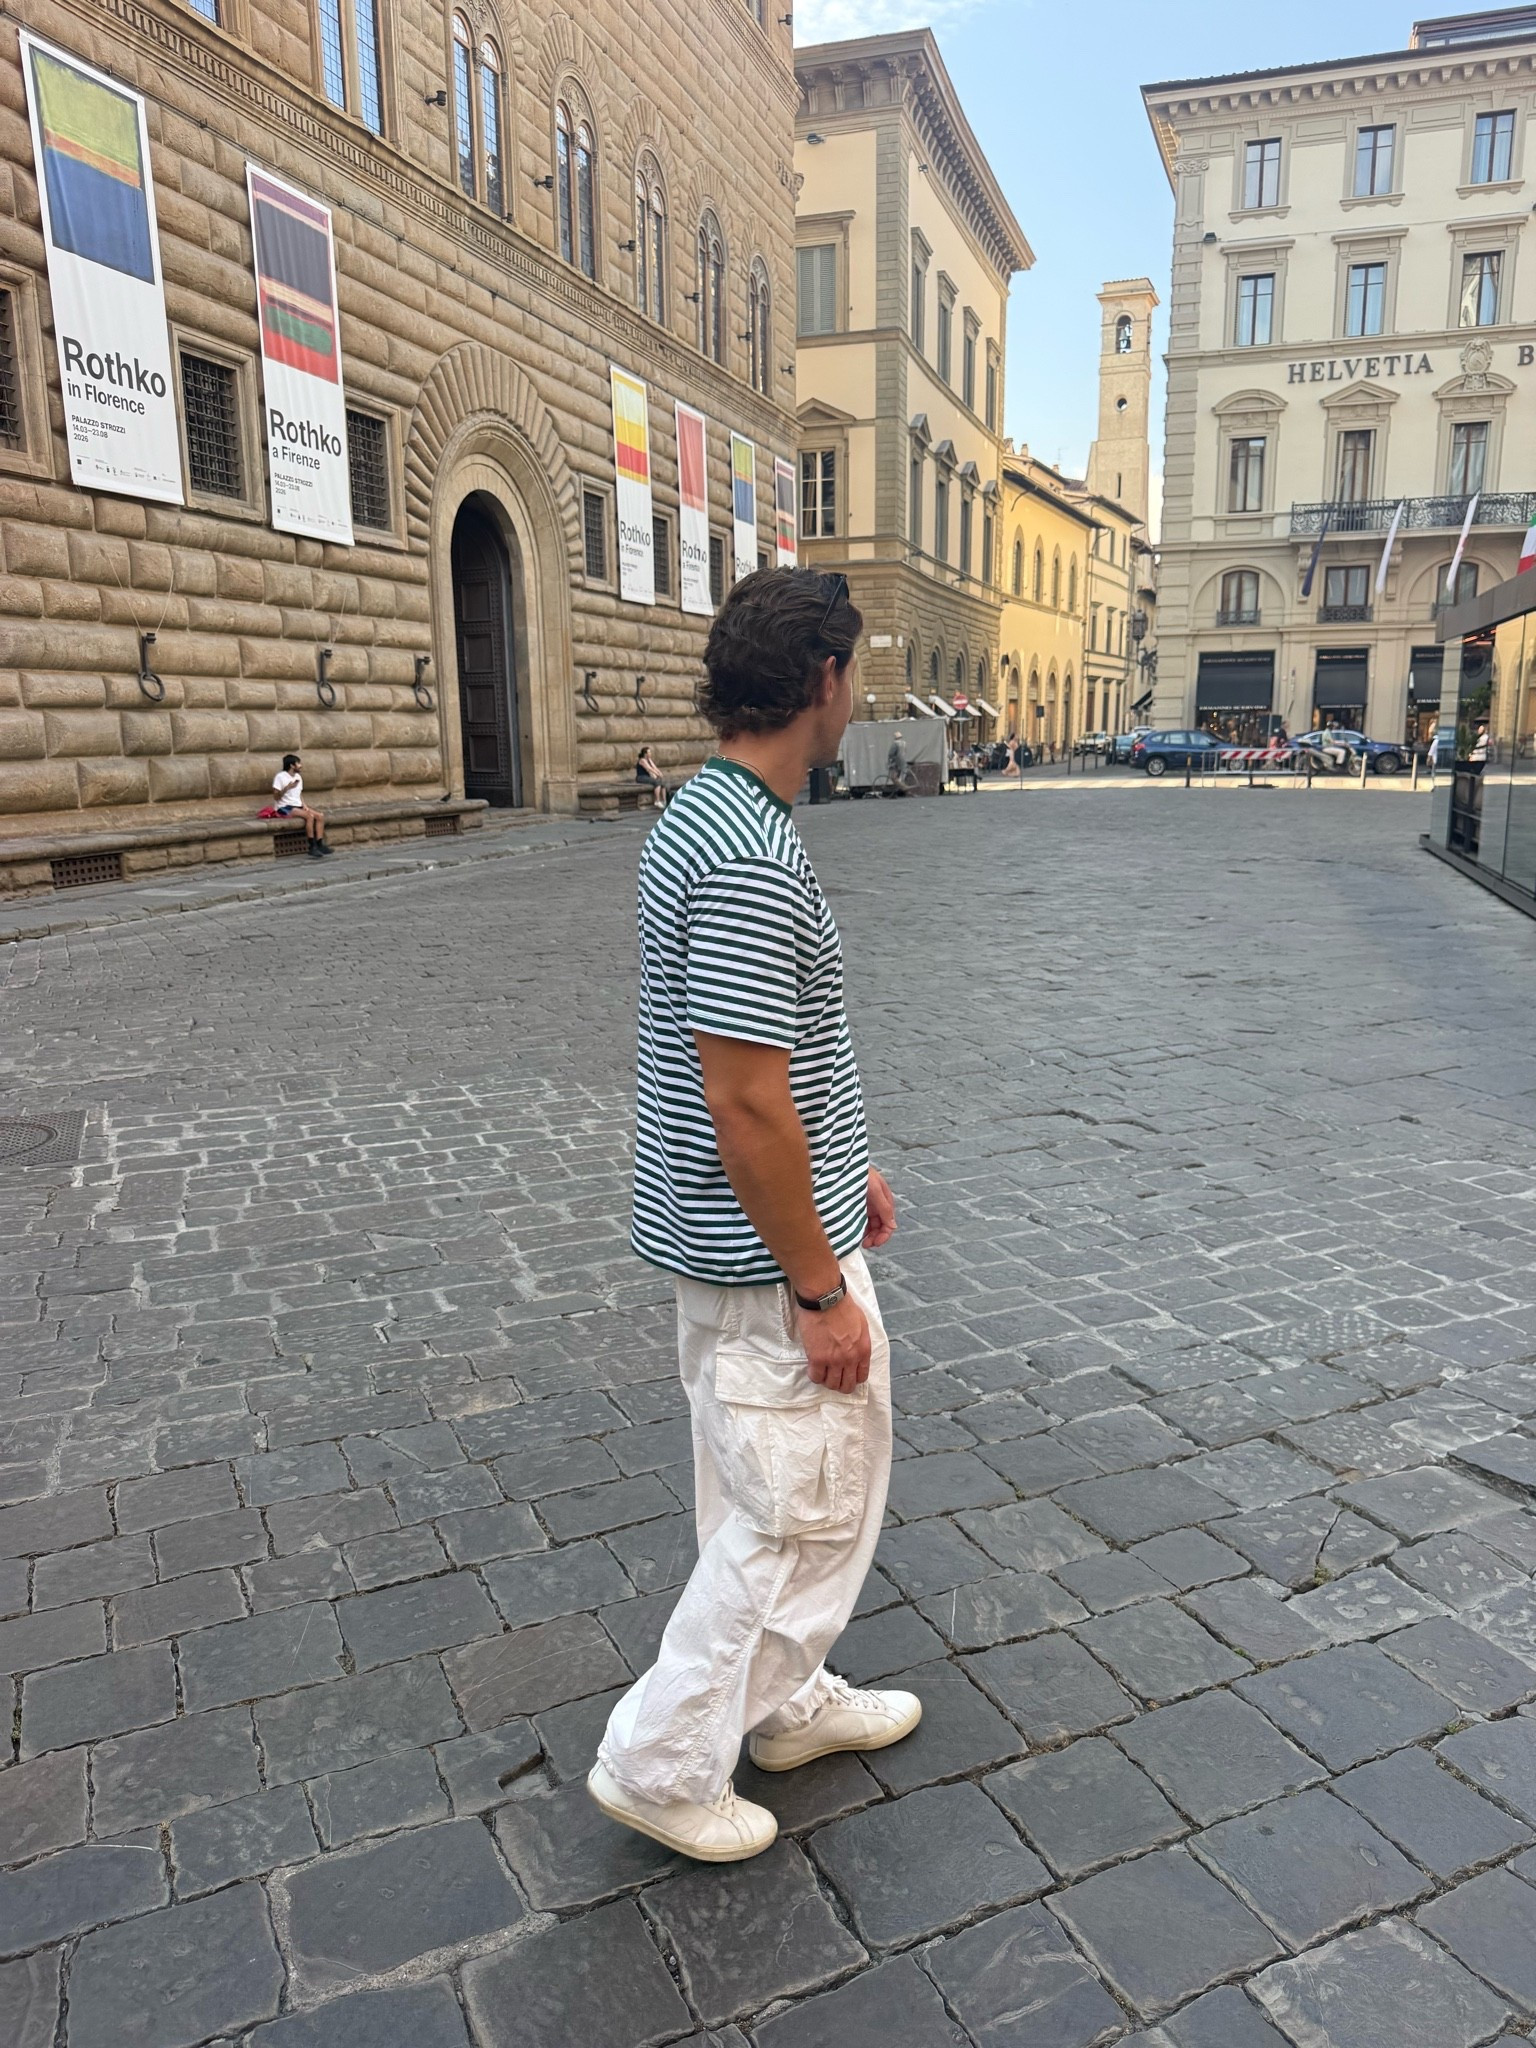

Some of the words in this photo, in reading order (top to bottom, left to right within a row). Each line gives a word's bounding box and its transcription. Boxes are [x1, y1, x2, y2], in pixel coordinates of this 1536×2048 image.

[62, 335, 167, 398] Rothko
[1287, 353, 1434, 384] HELVETIA
[1517, 344, 1535, 367] B
[67, 378, 81, 399] in
[84, 382, 146, 415] Florence
[71, 414, 100, 428] PALAZZO
[100, 421, 126, 434] STROZZI
[73, 432, 89, 443] 2026
[269, 408, 342, 457] Rothko
[272, 446, 279, 458] a
[281, 446, 321, 470] Firenze
[620, 520, 651, 547] Rothko
